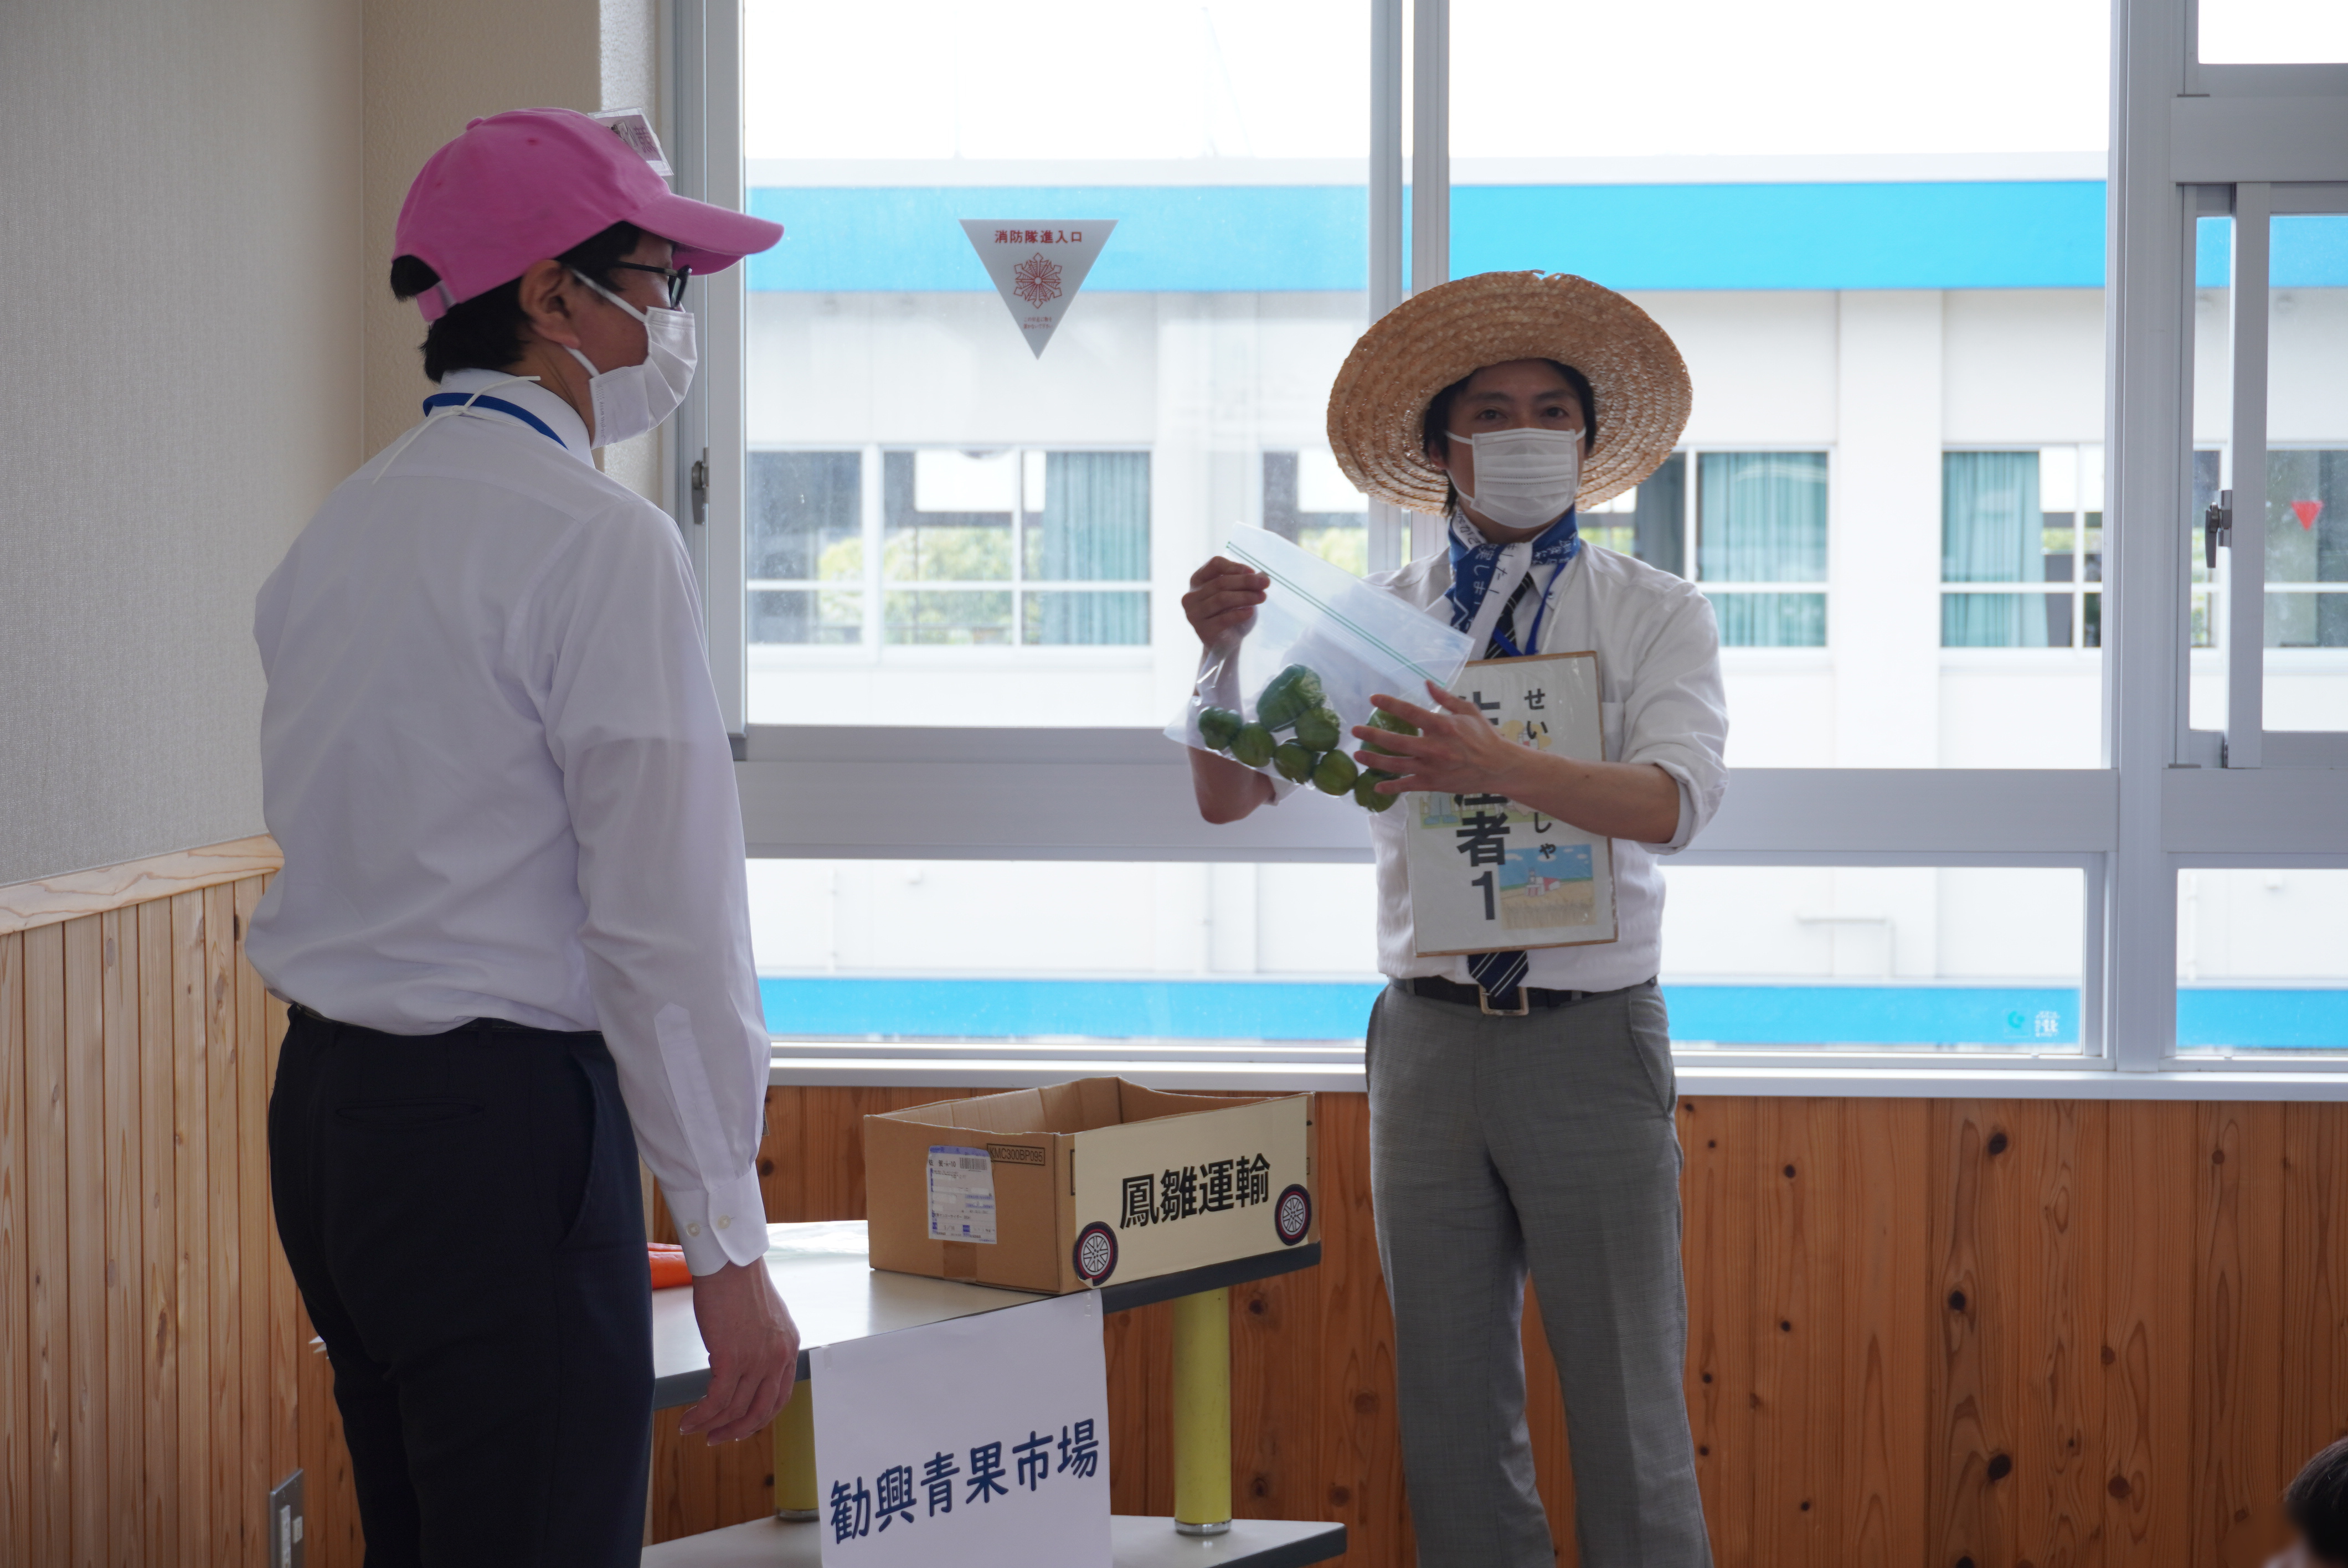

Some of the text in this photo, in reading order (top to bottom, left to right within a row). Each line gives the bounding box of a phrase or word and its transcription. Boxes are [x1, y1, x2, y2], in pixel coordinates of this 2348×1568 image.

[995, 230, 1083, 244] 消防隊進入口
[1456, 691, 1510, 921] 者1
[1524, 688, 1556, 859] せいしゃ
[990, 1147, 1043, 1162] KMC300BP095
[1120, 1153, 1271, 1229] 鳳雛運輸
[830, 1418, 1099, 1544] 勧興青果市場
